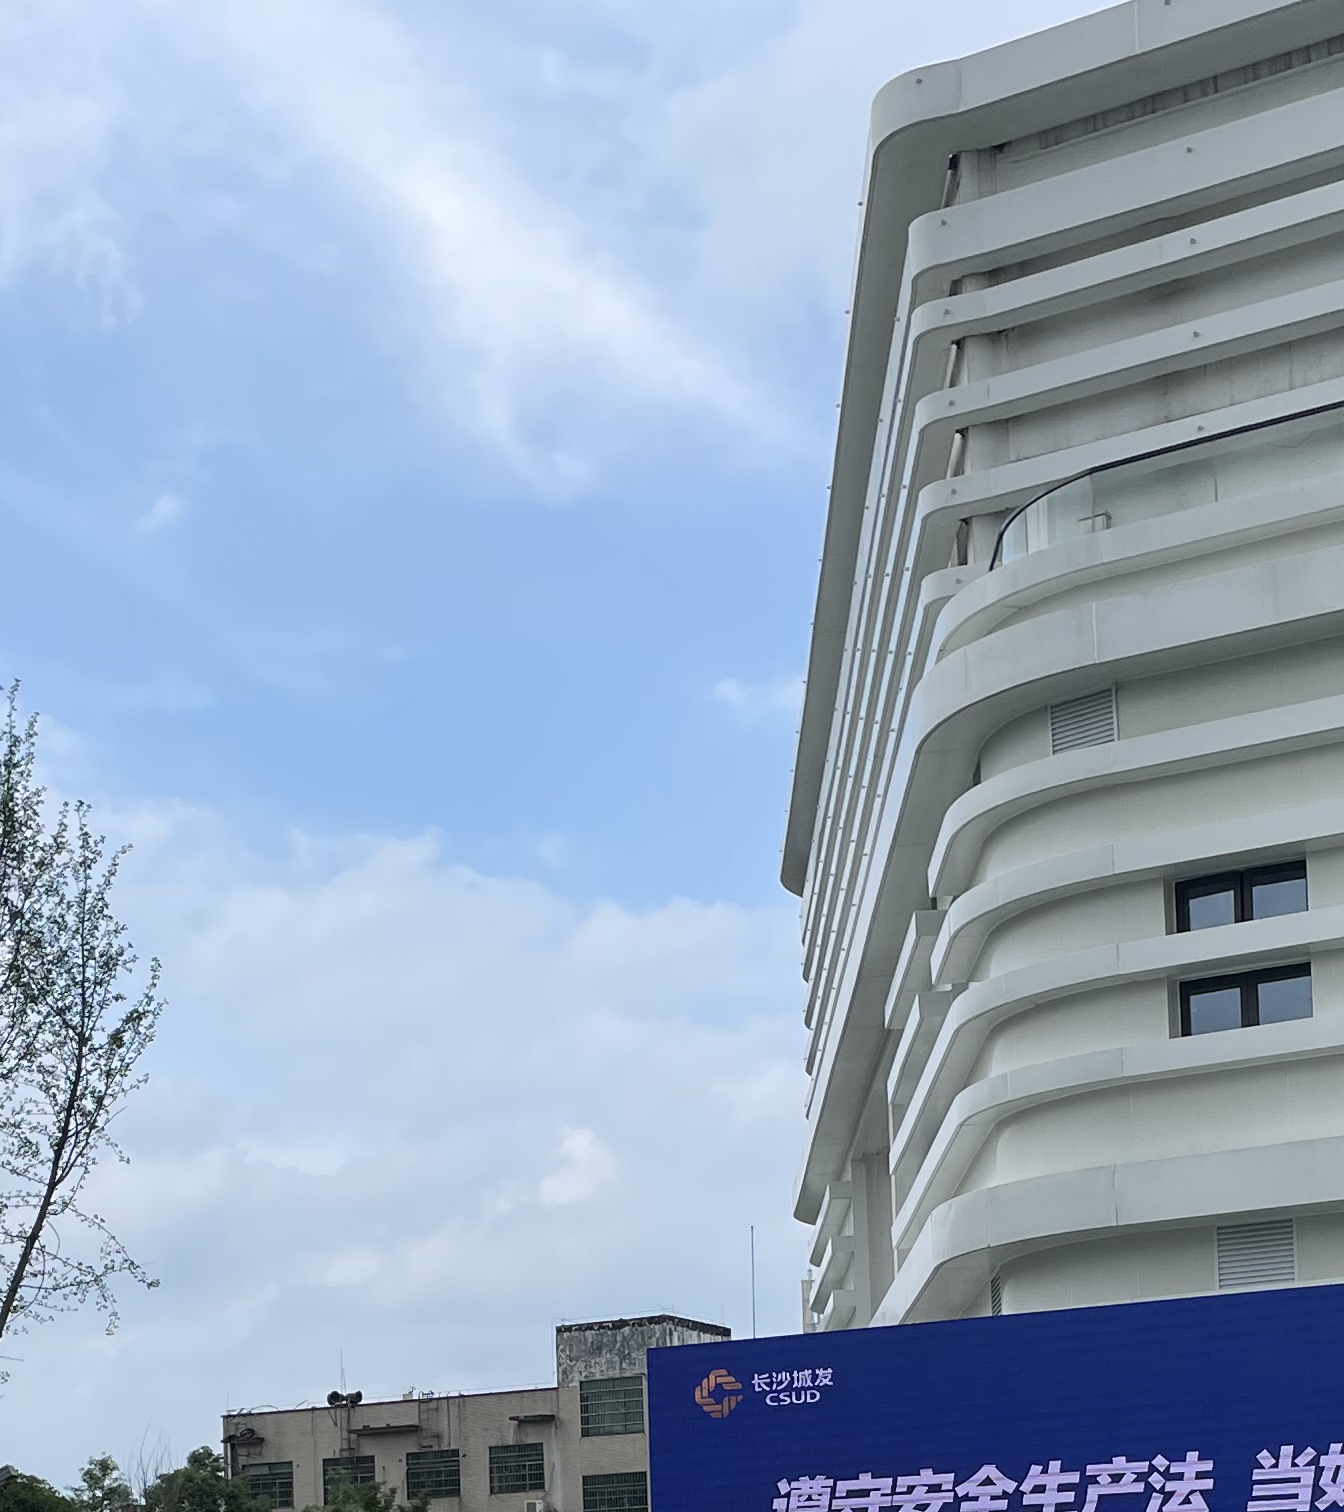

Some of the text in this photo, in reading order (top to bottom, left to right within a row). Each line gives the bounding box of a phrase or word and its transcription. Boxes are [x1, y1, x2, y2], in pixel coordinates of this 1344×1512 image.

[751, 1367, 834, 1392] 长沙城发
[765, 1389, 821, 1406] CSUD
